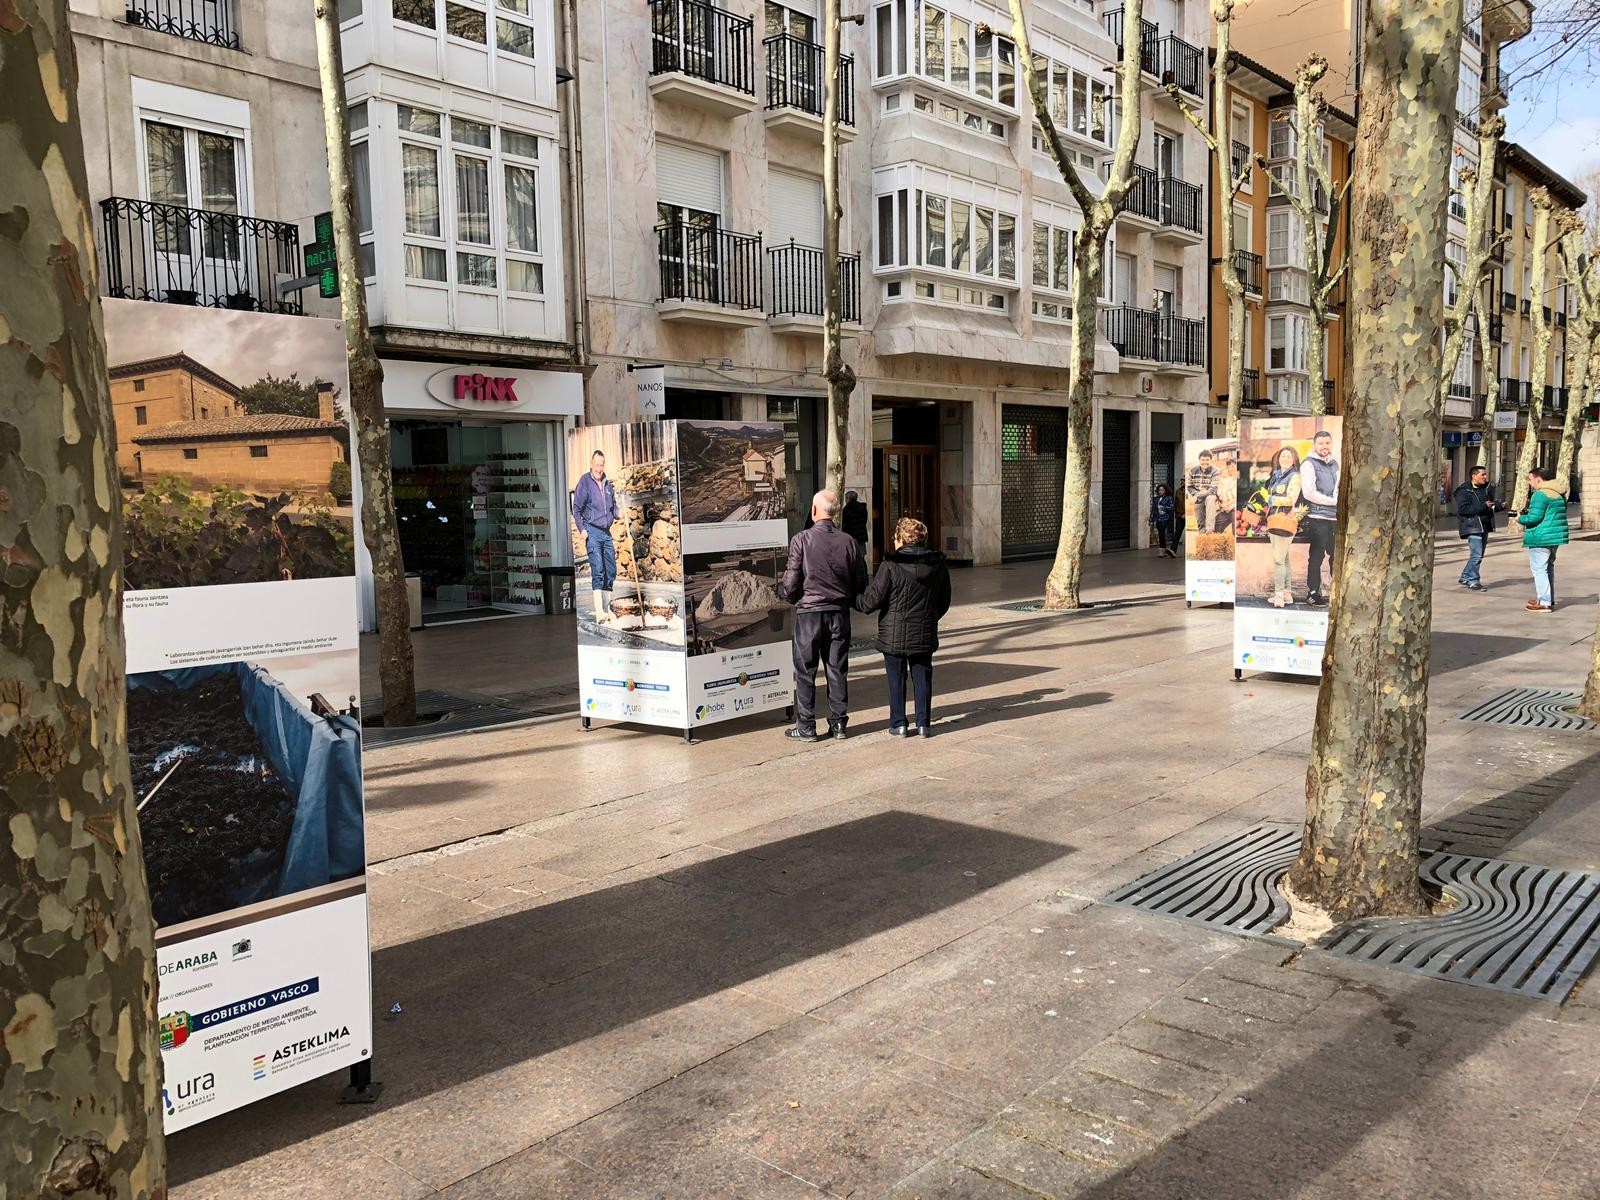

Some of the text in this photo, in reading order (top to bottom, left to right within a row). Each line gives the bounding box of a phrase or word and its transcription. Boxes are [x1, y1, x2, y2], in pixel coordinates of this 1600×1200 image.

[637, 382, 663, 393] NANOS
[743, 696, 754, 705] ura
[767, 690, 789, 699] ASTEKLIMA
[705, 702, 725, 713] ihobe
[174, 982, 213, 998] ORGANIZADORES
[201, 983, 309, 1025] GOBIERNO VASCO
[203, 1025, 252, 1046] DEPARTAMENTO
[261, 1015, 281, 1026] MEDIO
[204, 1032, 249, 1052] PLANIFICACIÓN
[250, 1021, 287, 1036] TERRITORIAL
[292, 1009, 317, 1022] VIVIENDA
[271, 1026, 350, 1062] ASTEKLIMA
[177, 1072, 215, 1099] ura
